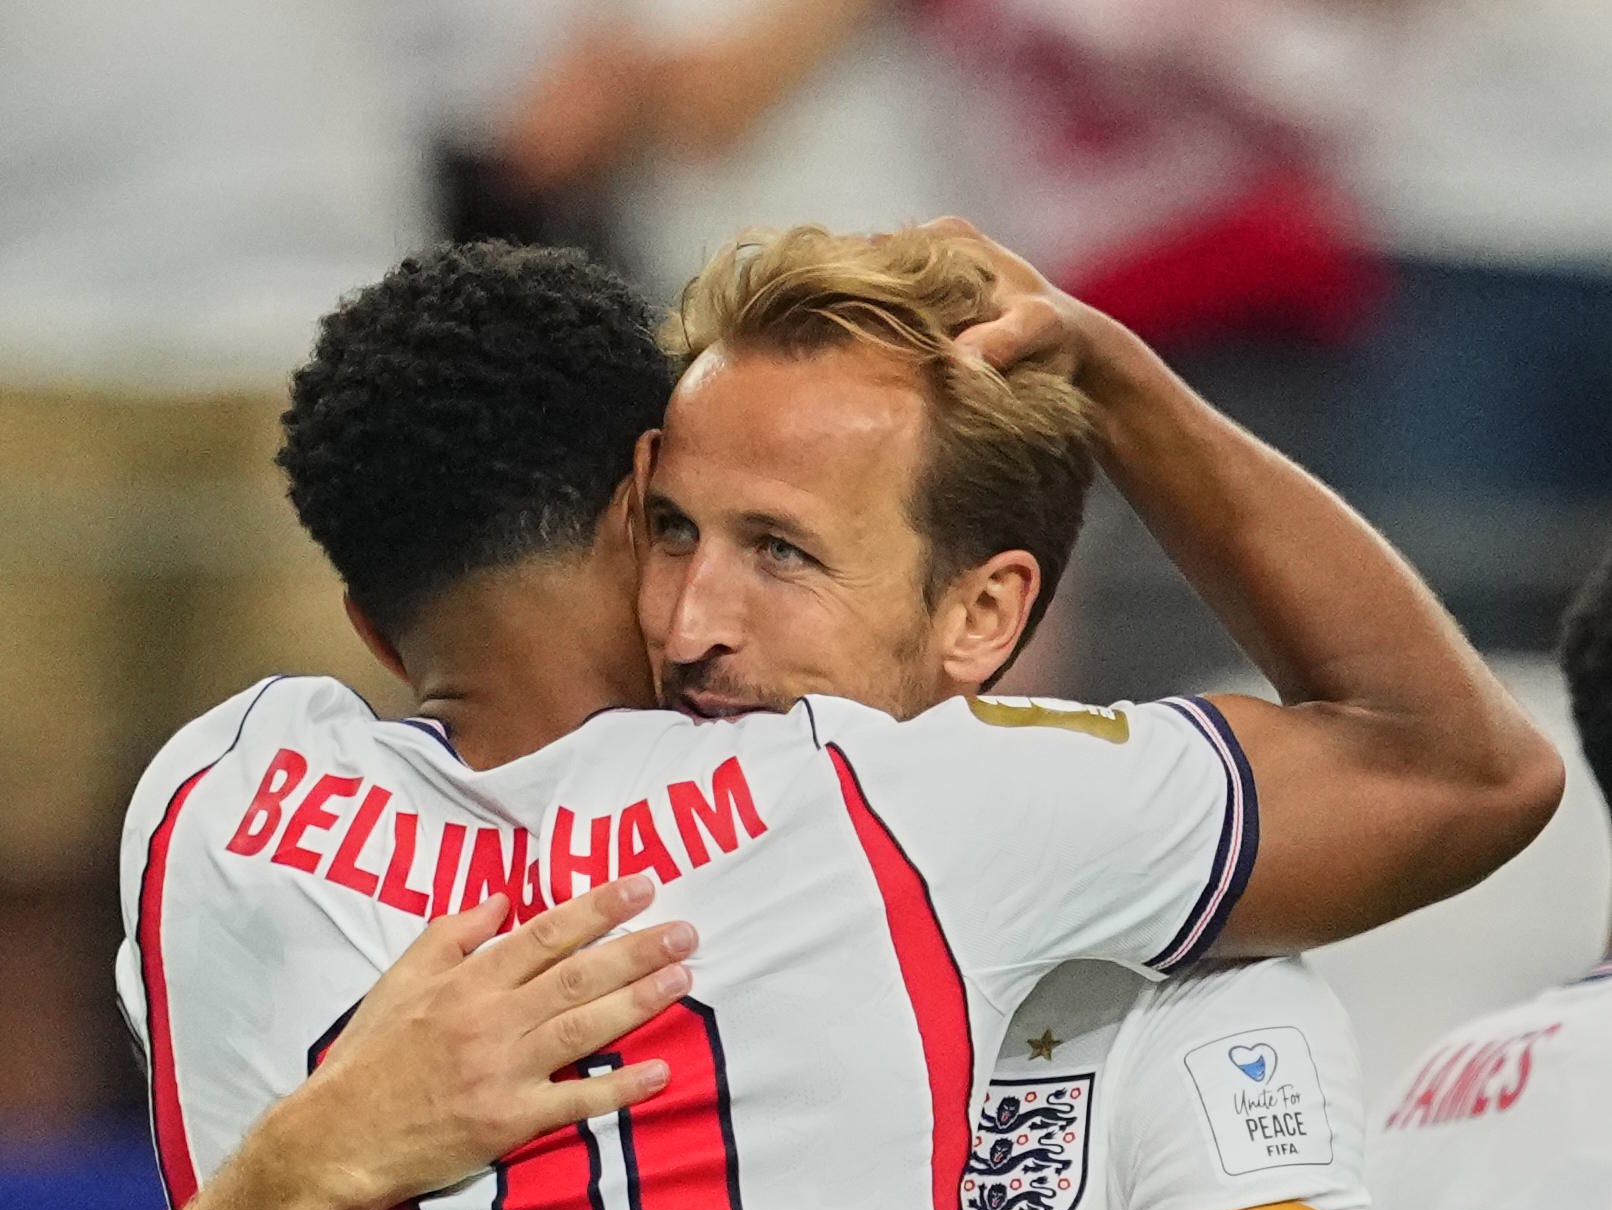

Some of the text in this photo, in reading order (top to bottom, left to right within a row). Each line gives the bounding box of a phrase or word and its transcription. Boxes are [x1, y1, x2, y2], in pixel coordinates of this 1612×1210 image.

[1233, 1083, 1301, 1117] Unite For
[1245, 1111, 1308, 1142] PEACE
[1266, 1142, 1300, 1157] FIFA
